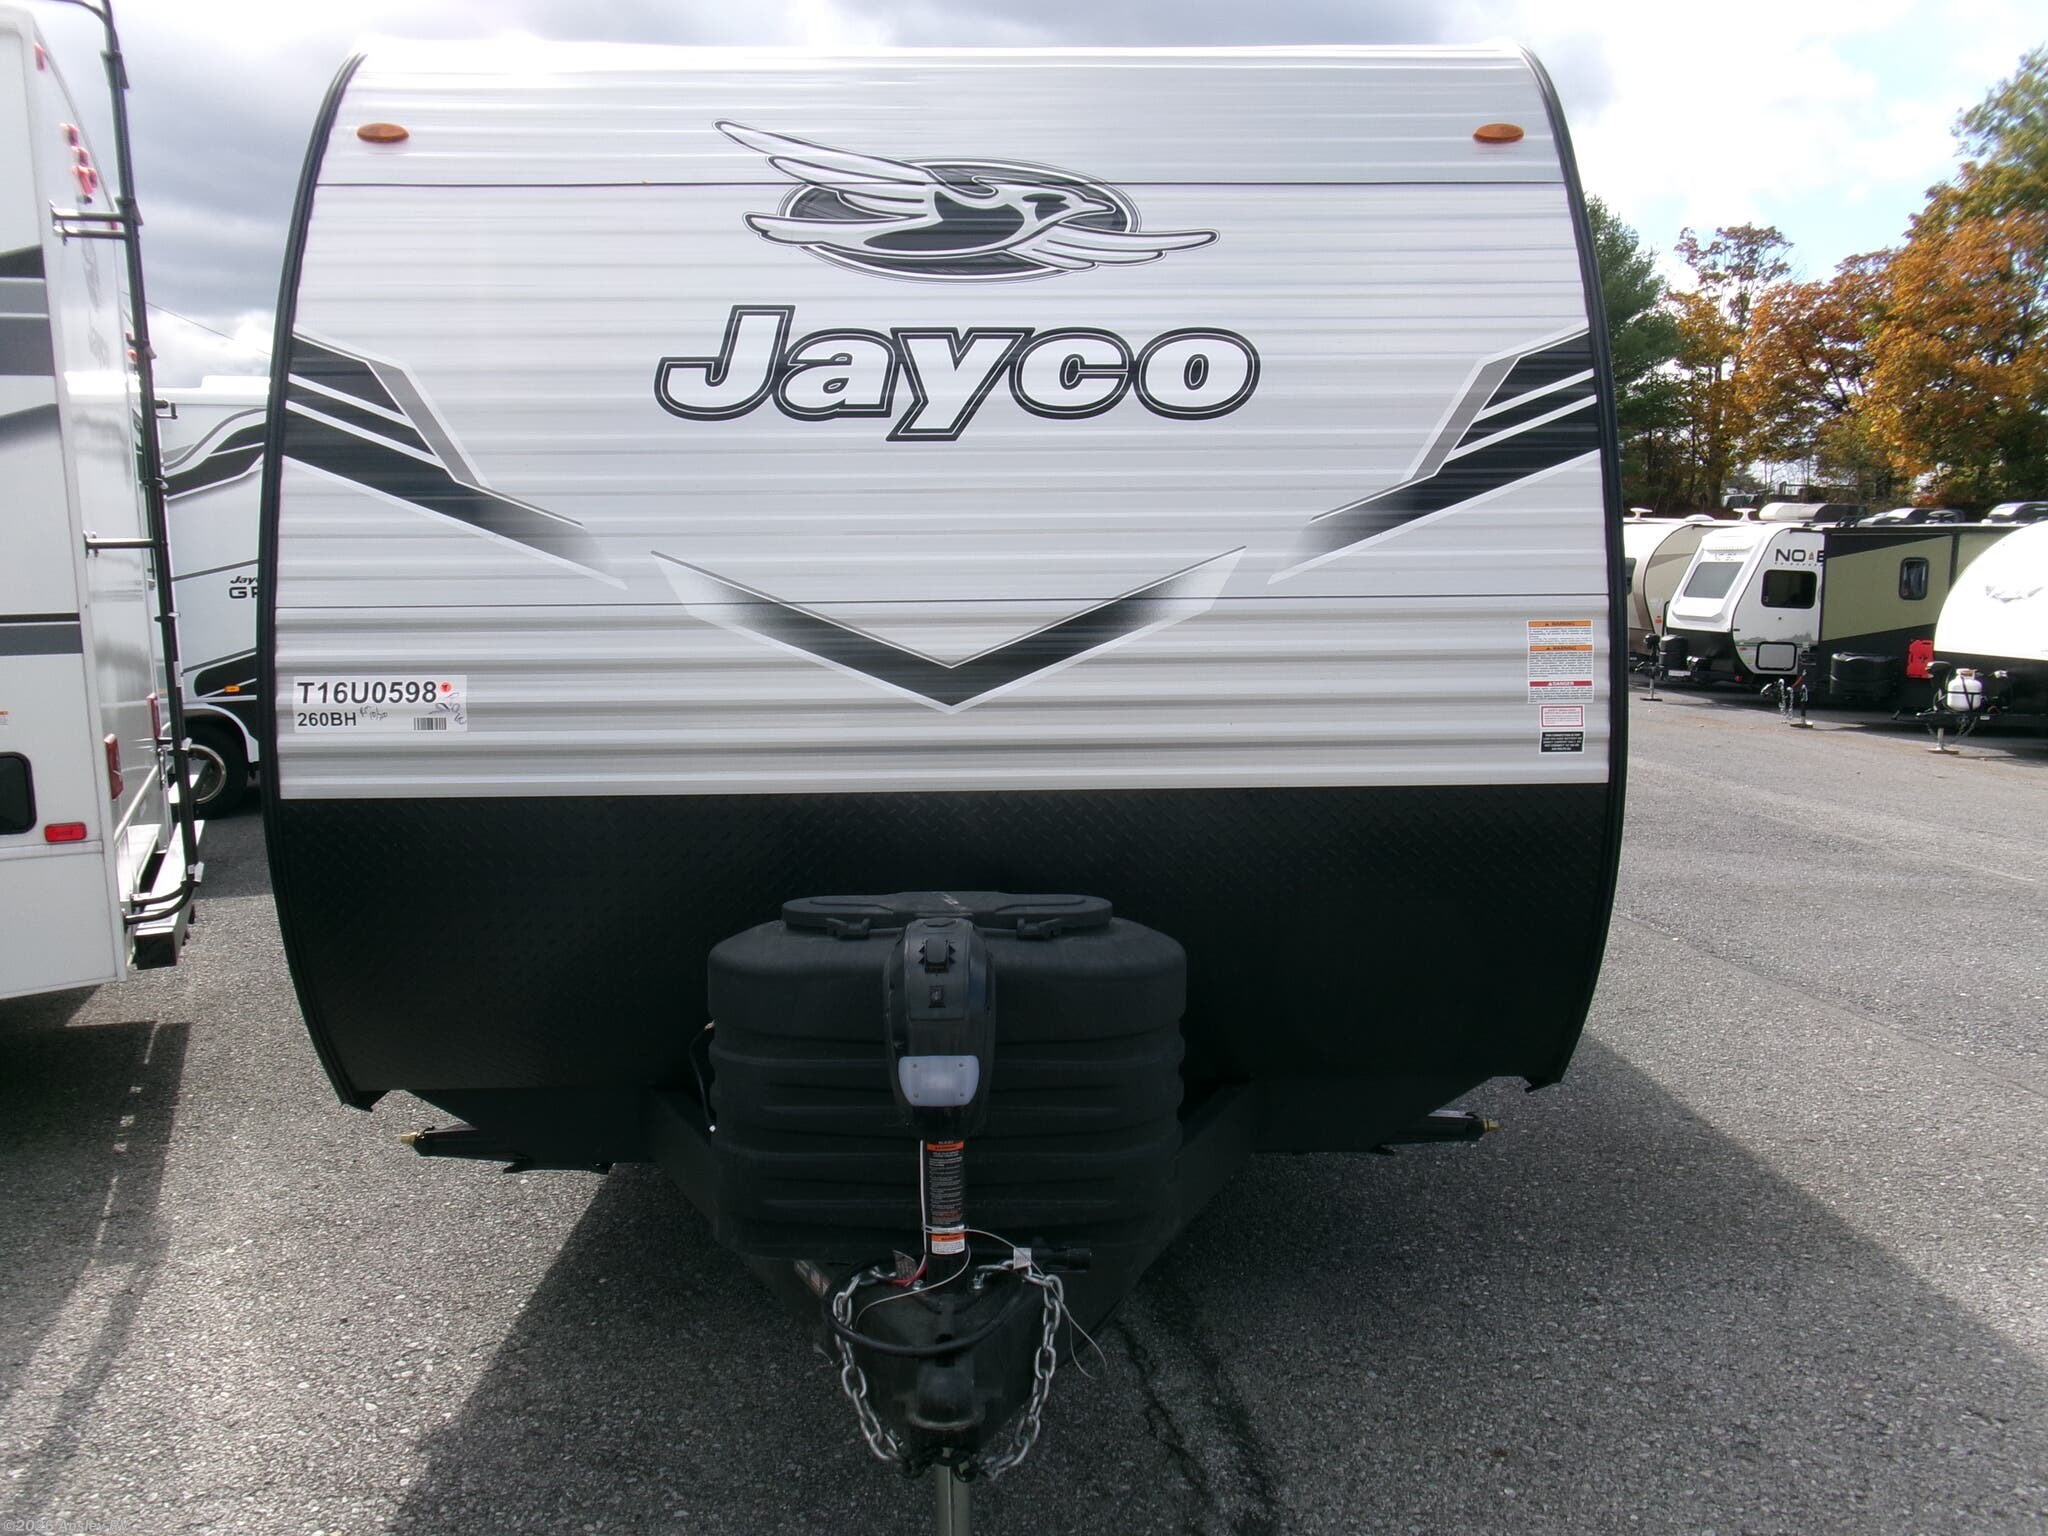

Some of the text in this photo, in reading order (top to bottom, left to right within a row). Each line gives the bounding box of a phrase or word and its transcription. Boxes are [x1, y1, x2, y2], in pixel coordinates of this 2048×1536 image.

[654, 305, 1260, 441] Jayco
[230, 576, 257, 585] Jay
[297, 681, 437, 704] T16U0598
[298, 712, 357, 726] 260BH
